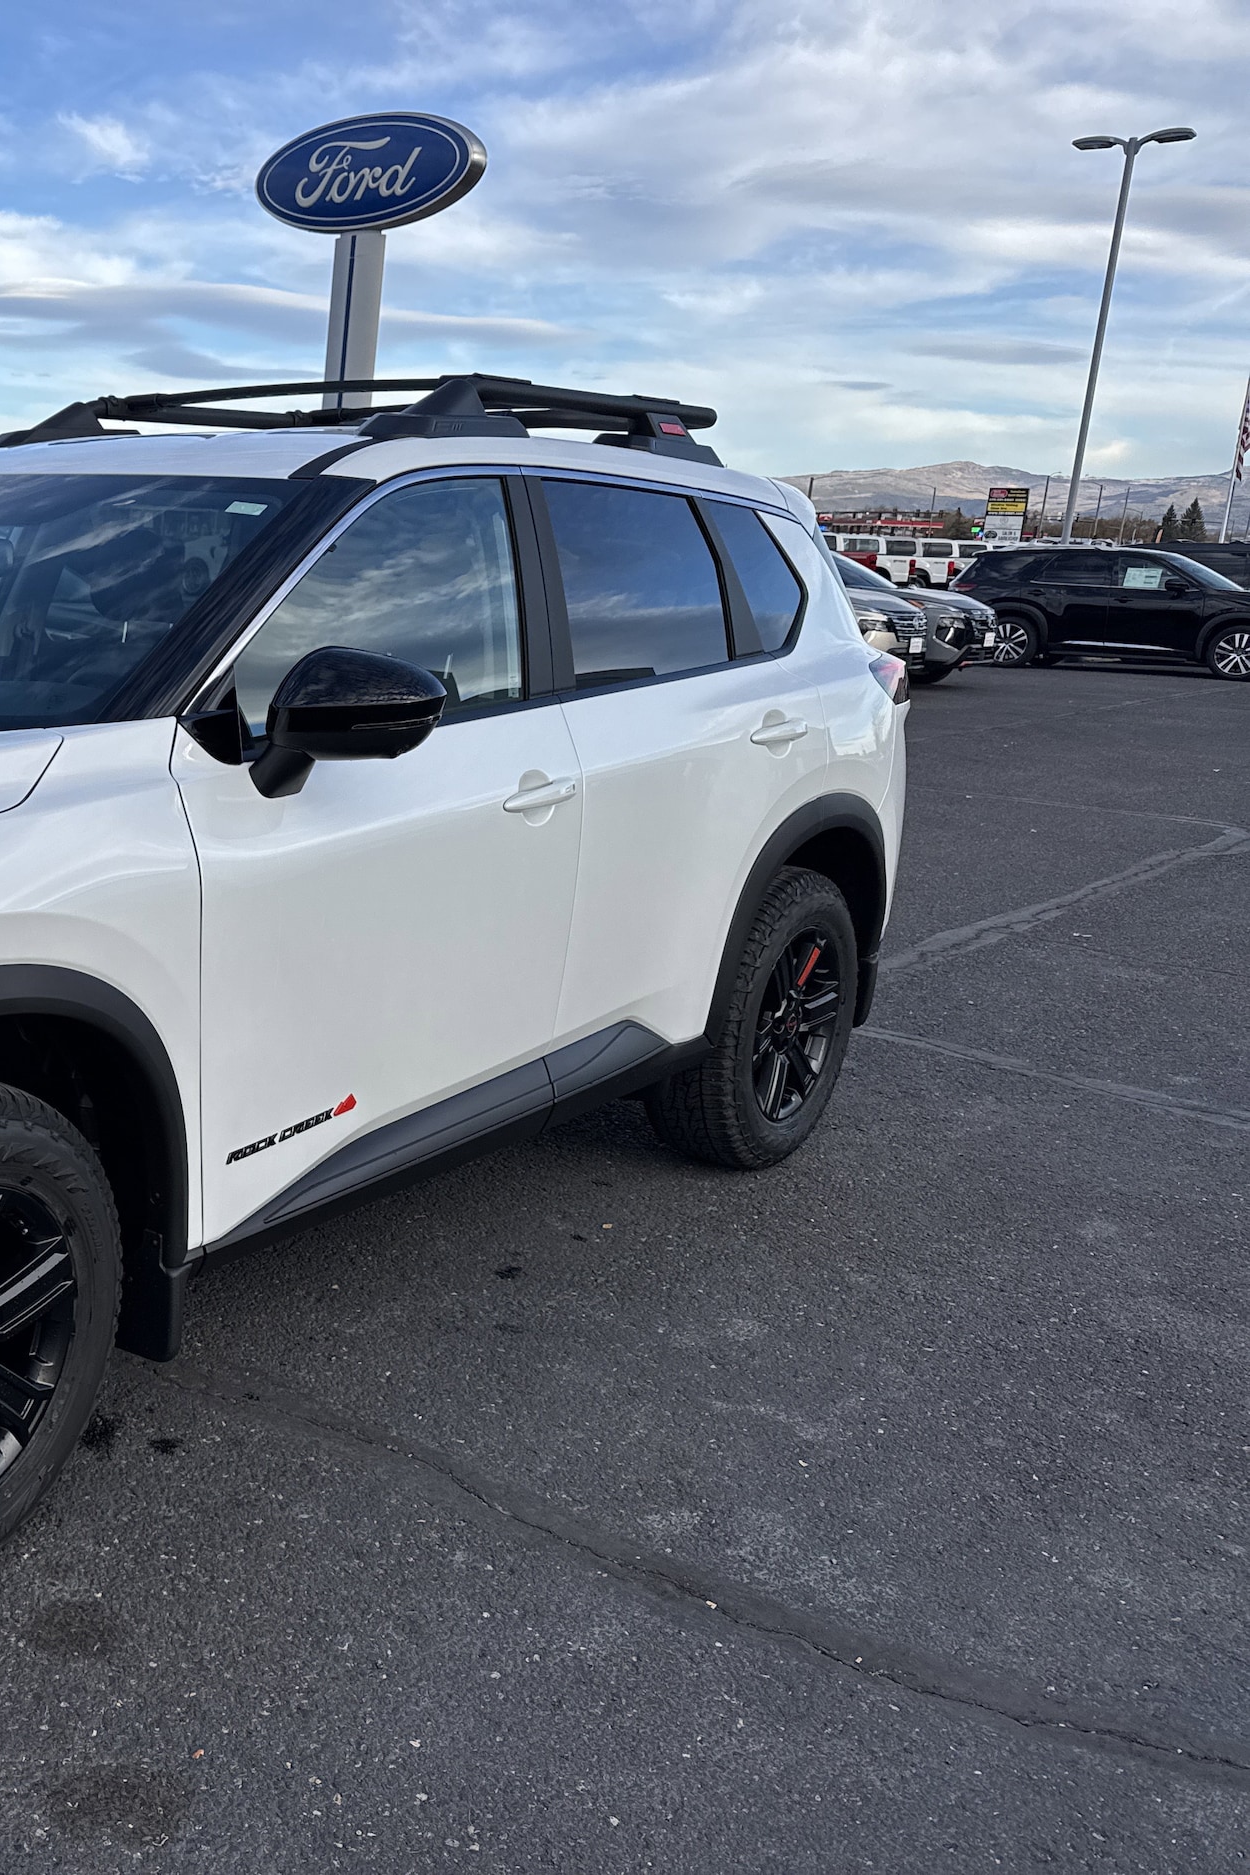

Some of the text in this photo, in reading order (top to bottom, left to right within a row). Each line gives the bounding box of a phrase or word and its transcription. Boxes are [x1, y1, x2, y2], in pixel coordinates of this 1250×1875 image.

[294, 136, 422, 208] Ford
[225, 1107, 334, 1165] ROCK CREEK
